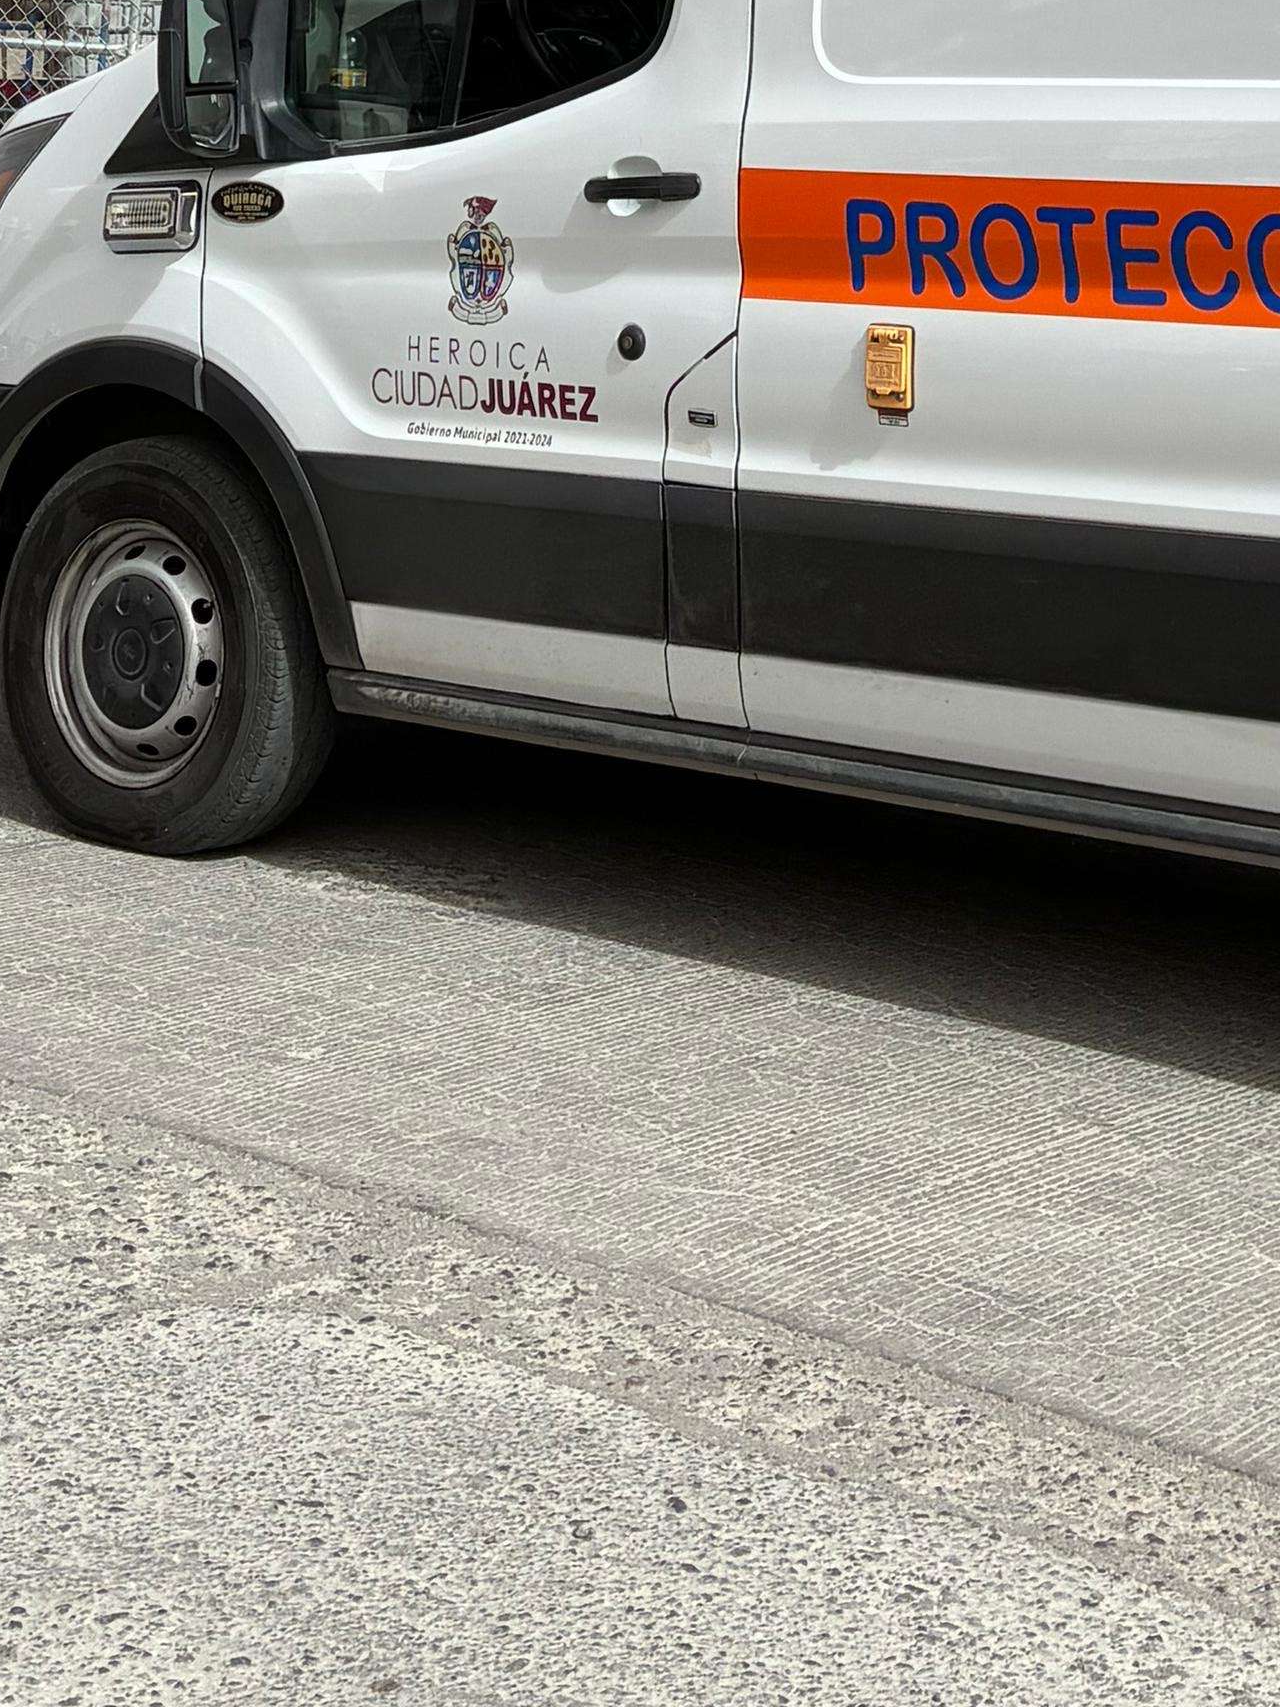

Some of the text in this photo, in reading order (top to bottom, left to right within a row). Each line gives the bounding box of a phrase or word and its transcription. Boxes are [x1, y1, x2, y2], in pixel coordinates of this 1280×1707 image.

[407, 335, 551, 373] HEROICA
[407, 421, 452, 437] Gobierno
[453, 426, 502, 444] Municipal
